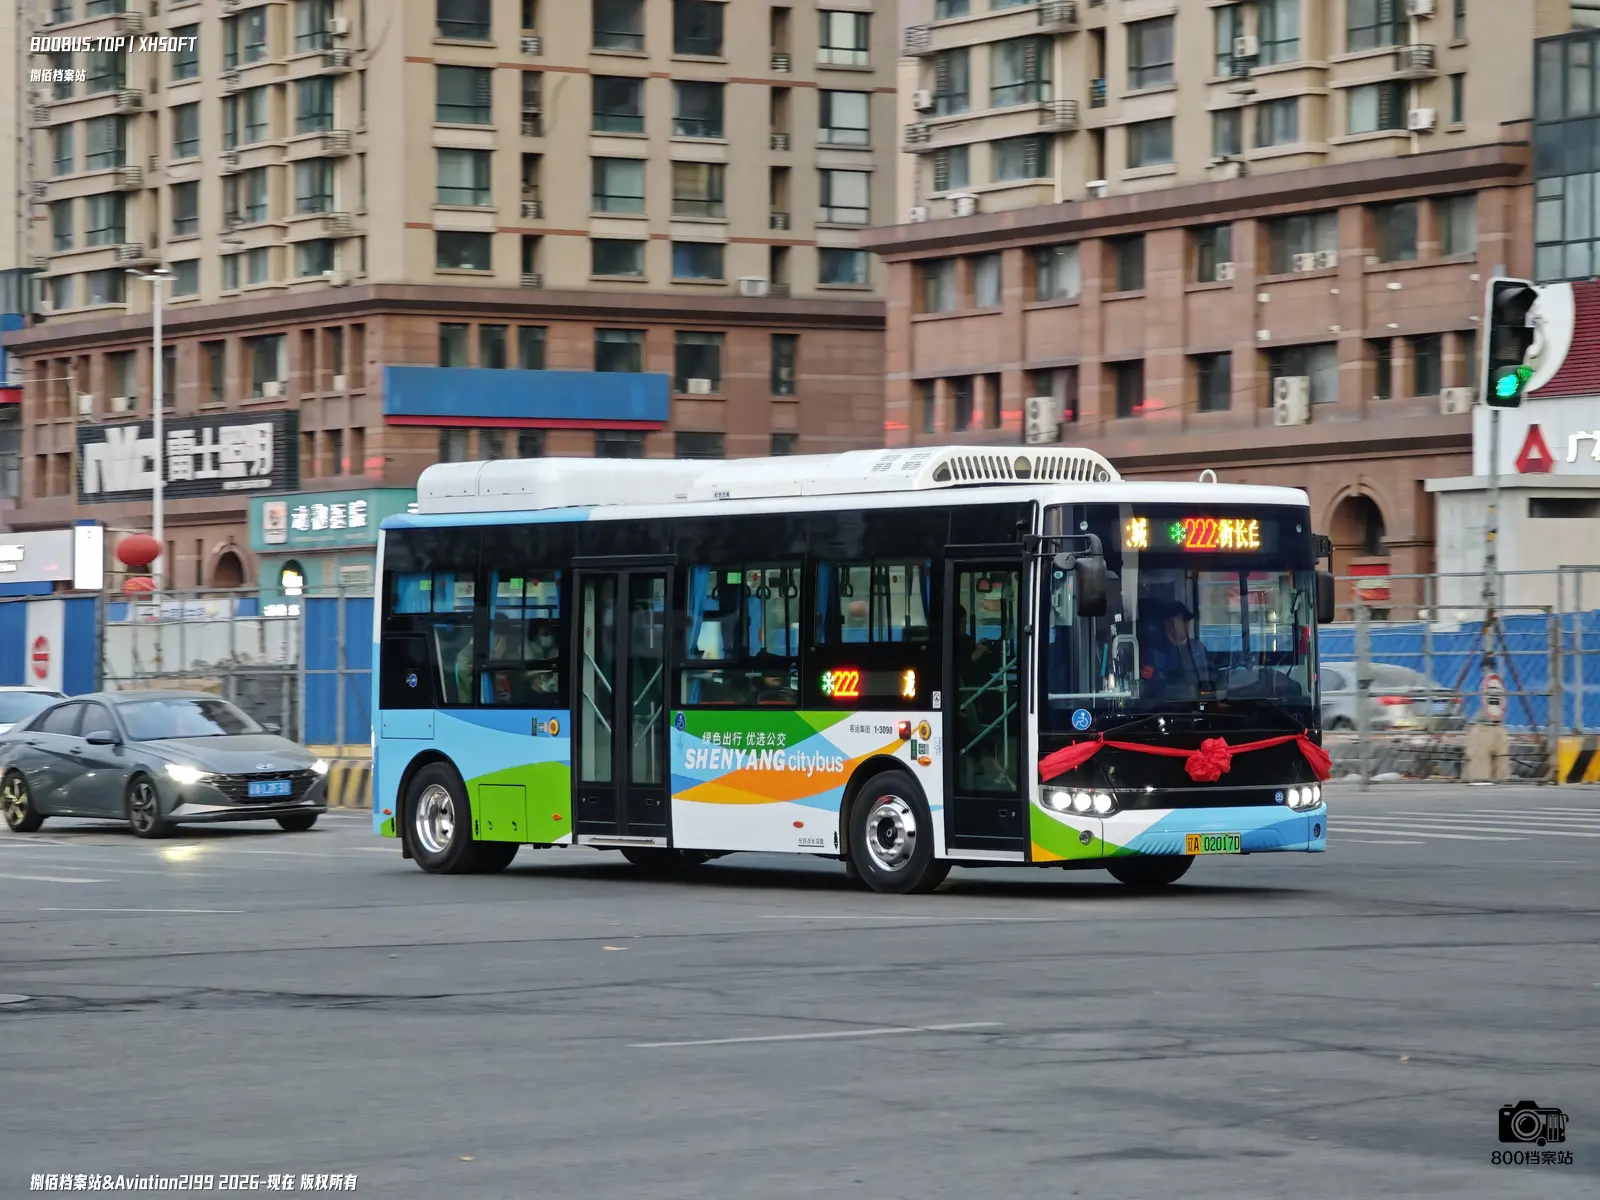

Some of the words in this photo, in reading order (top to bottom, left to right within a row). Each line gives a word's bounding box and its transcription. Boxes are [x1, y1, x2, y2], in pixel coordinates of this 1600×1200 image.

[833, 670, 860, 697] 222
[702, 731, 742, 746] 绿色出行
[746, 731, 786, 746] 优选公交
[684, 748, 786, 772] SHENYANG
[787, 750, 844, 777] citybus
